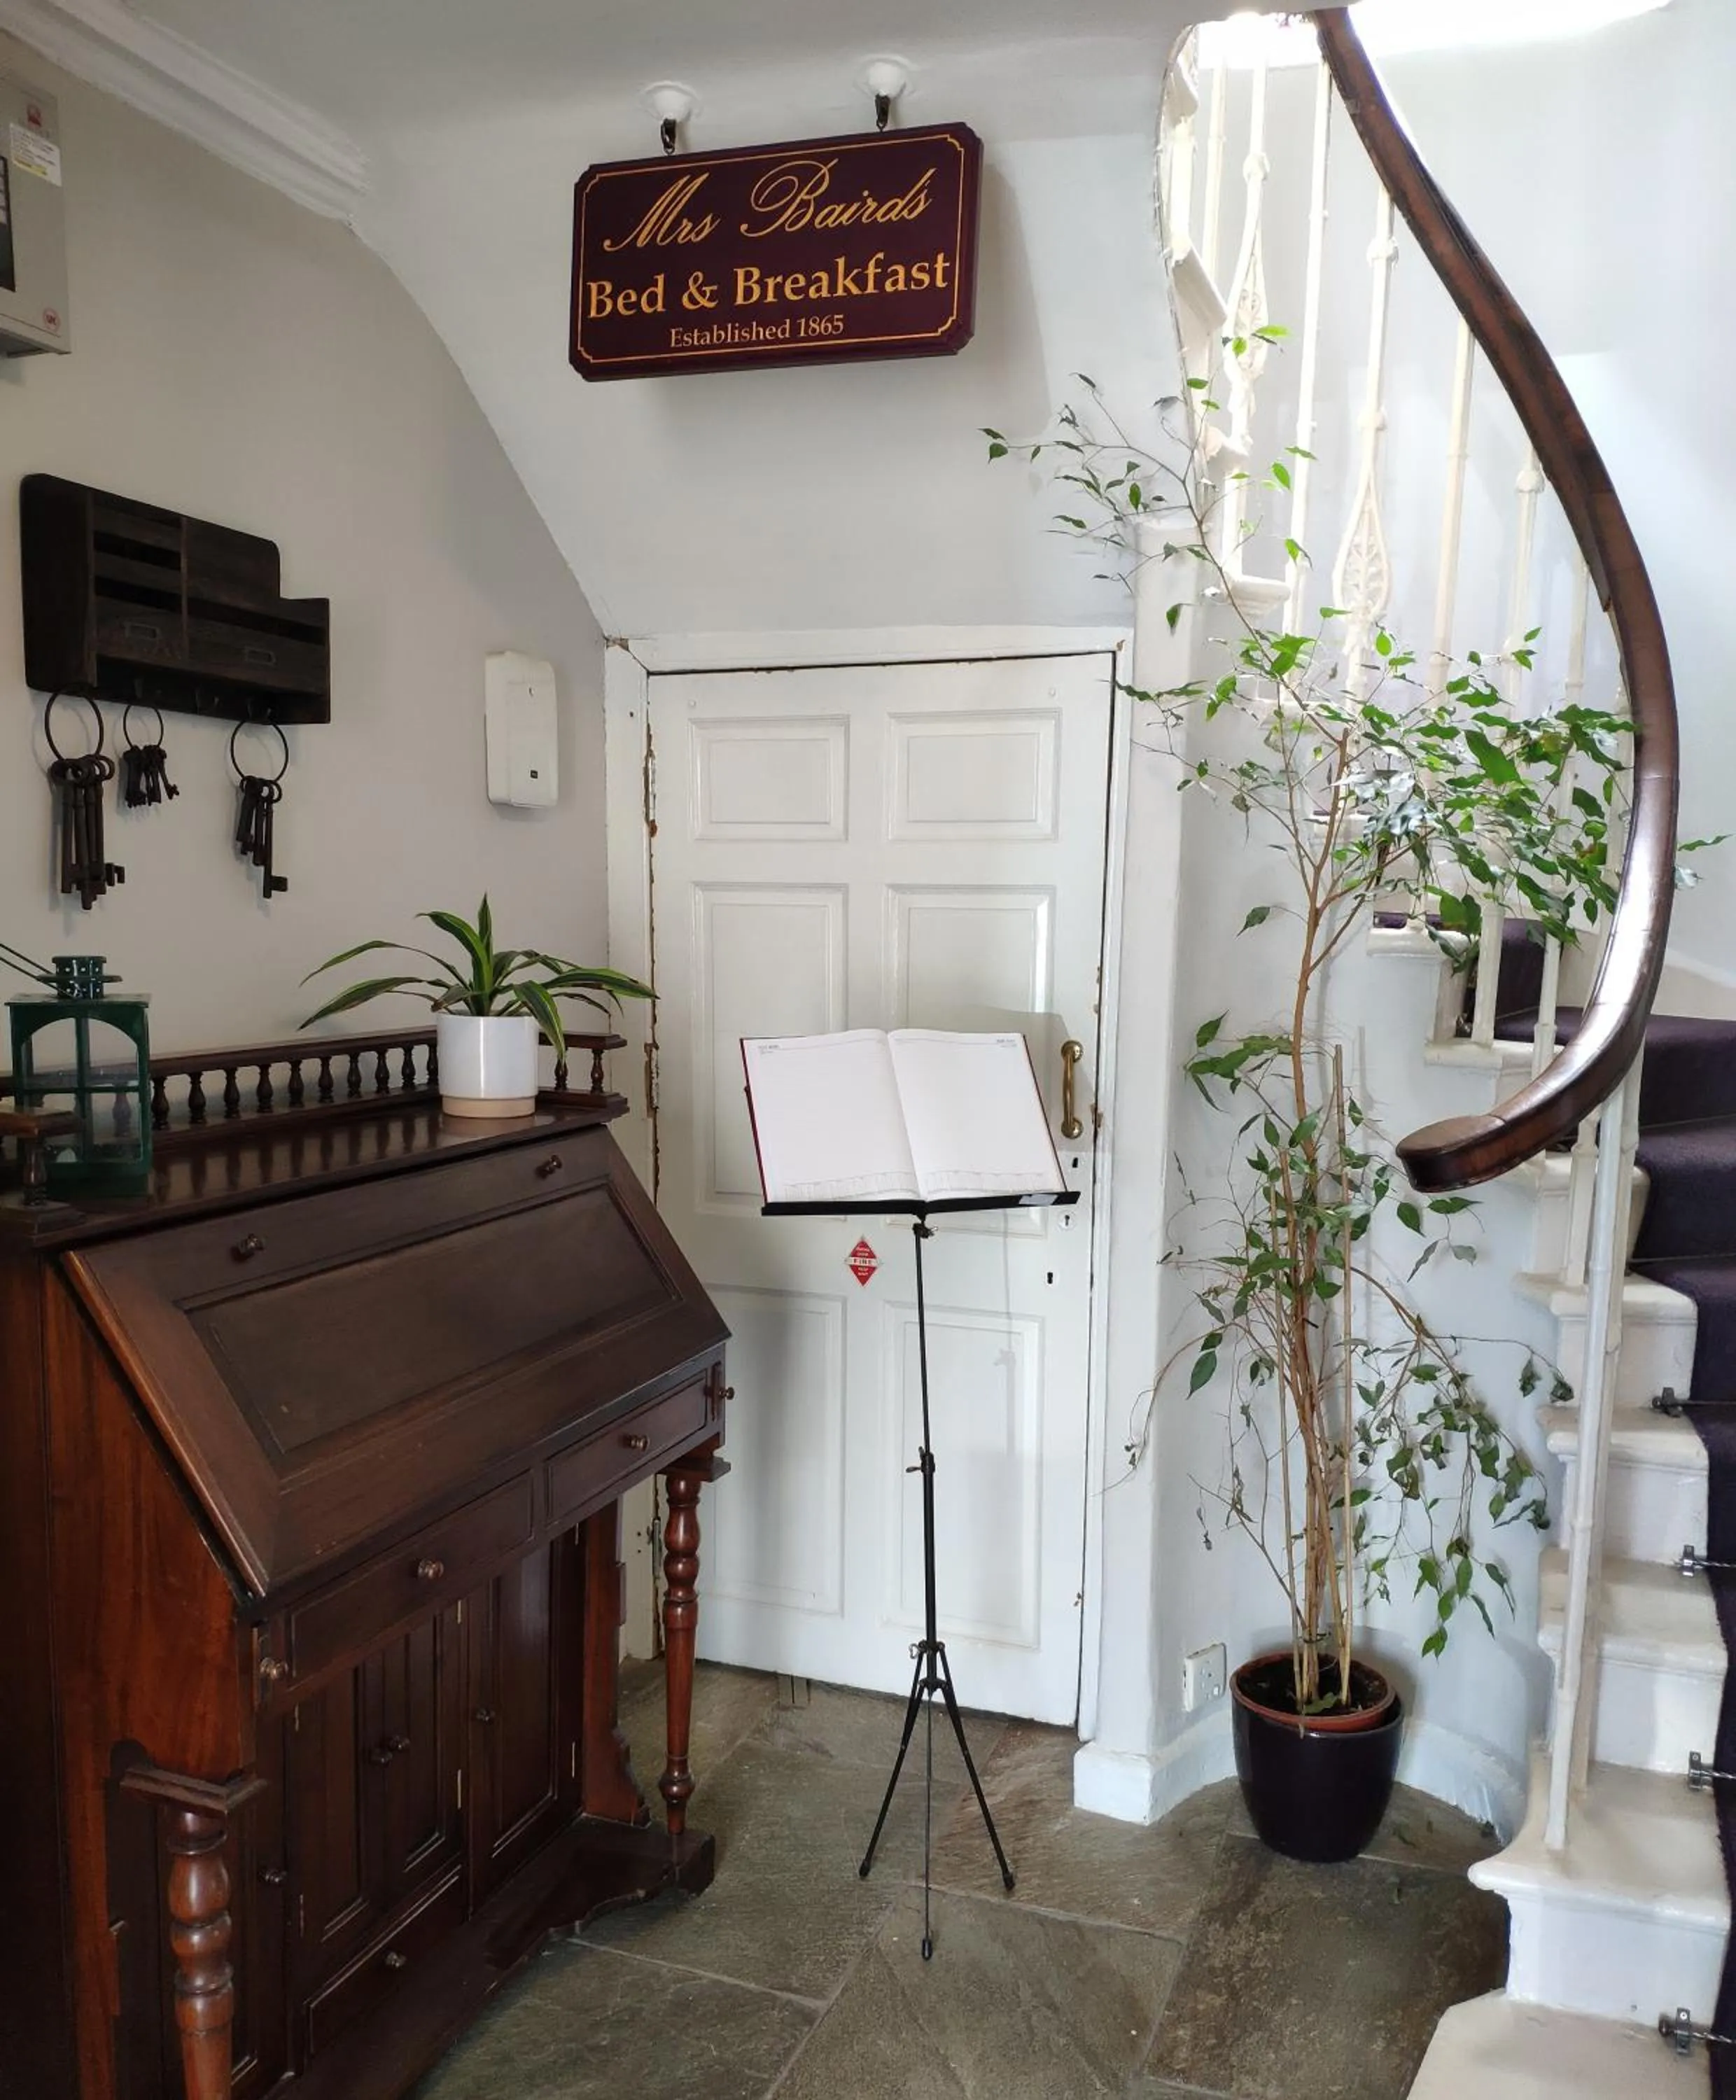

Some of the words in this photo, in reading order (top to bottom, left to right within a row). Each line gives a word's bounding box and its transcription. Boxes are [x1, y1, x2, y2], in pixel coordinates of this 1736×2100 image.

[603, 172, 720, 251] Mrs
[586, 274, 666, 318] Bed
[681, 271, 719, 310] &
[733, 251, 951, 306] Breakfast
[670, 318, 790, 348] Established
[796, 314, 844, 337] 1865
